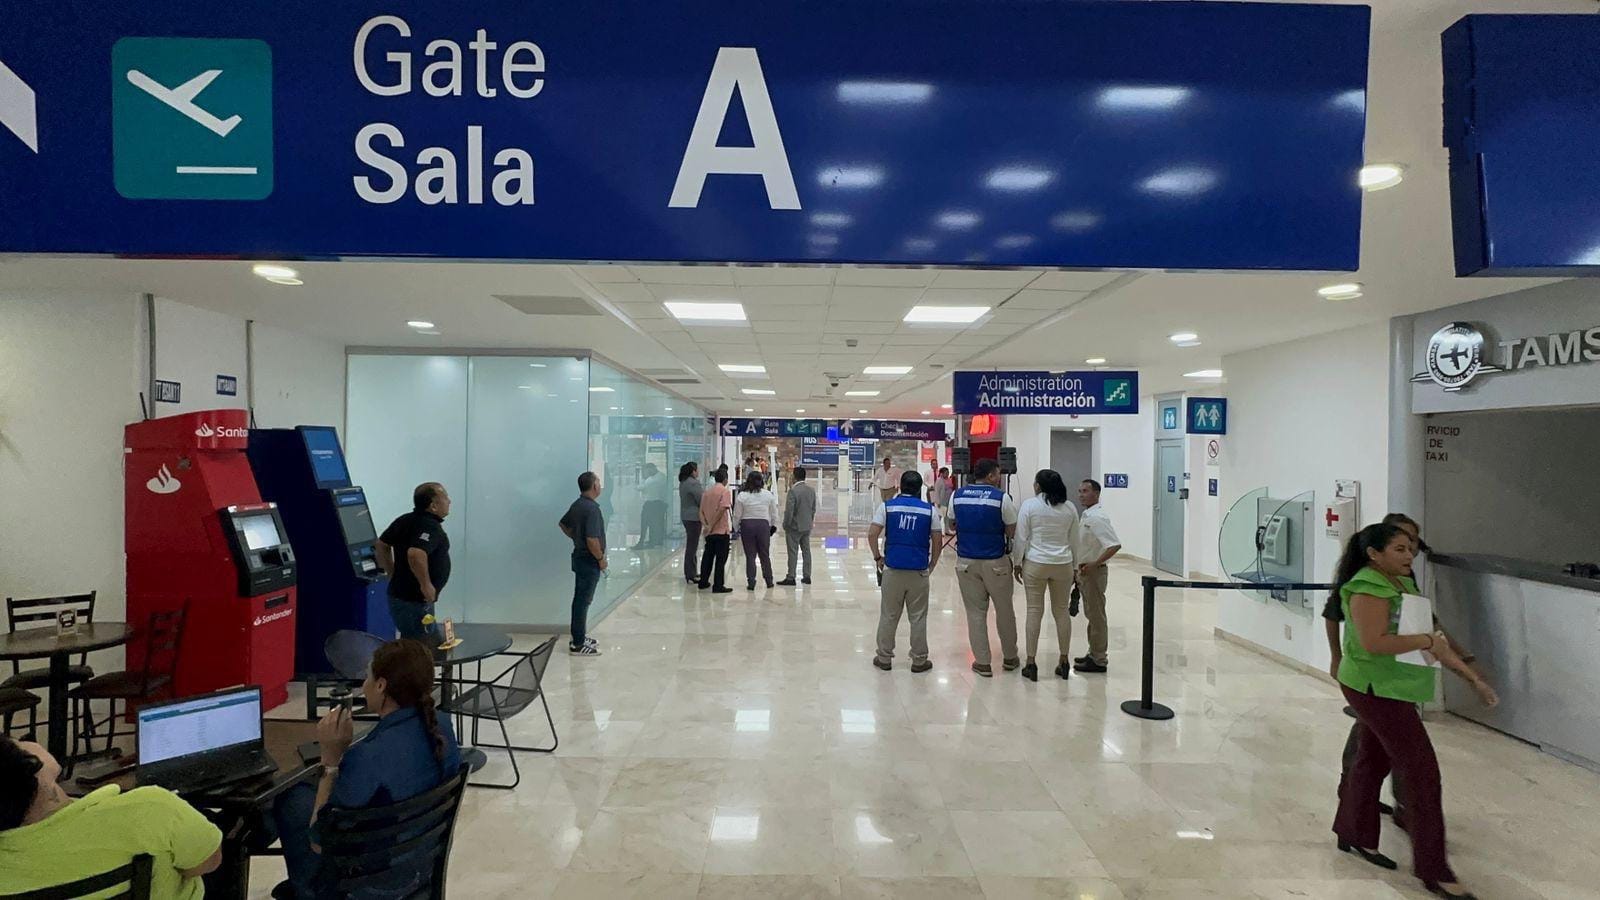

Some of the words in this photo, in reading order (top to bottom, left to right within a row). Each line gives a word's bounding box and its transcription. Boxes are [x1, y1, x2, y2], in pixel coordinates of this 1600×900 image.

[353, 15, 546, 99] Gate
[668, 47, 802, 210] A
[353, 122, 535, 205] Sala
[1499, 327, 1600, 370] TAMS
[979, 374, 1082, 392] Administration
[979, 392, 1096, 408] Administración
[745, 421, 757, 434] A
[880, 430, 929, 438] Documentación
[1429, 438, 1443, 448] DE
[1425, 451, 1448, 462] TAXI
[898, 514, 917, 531] MTT
[262, 608, 293, 624] Santander
